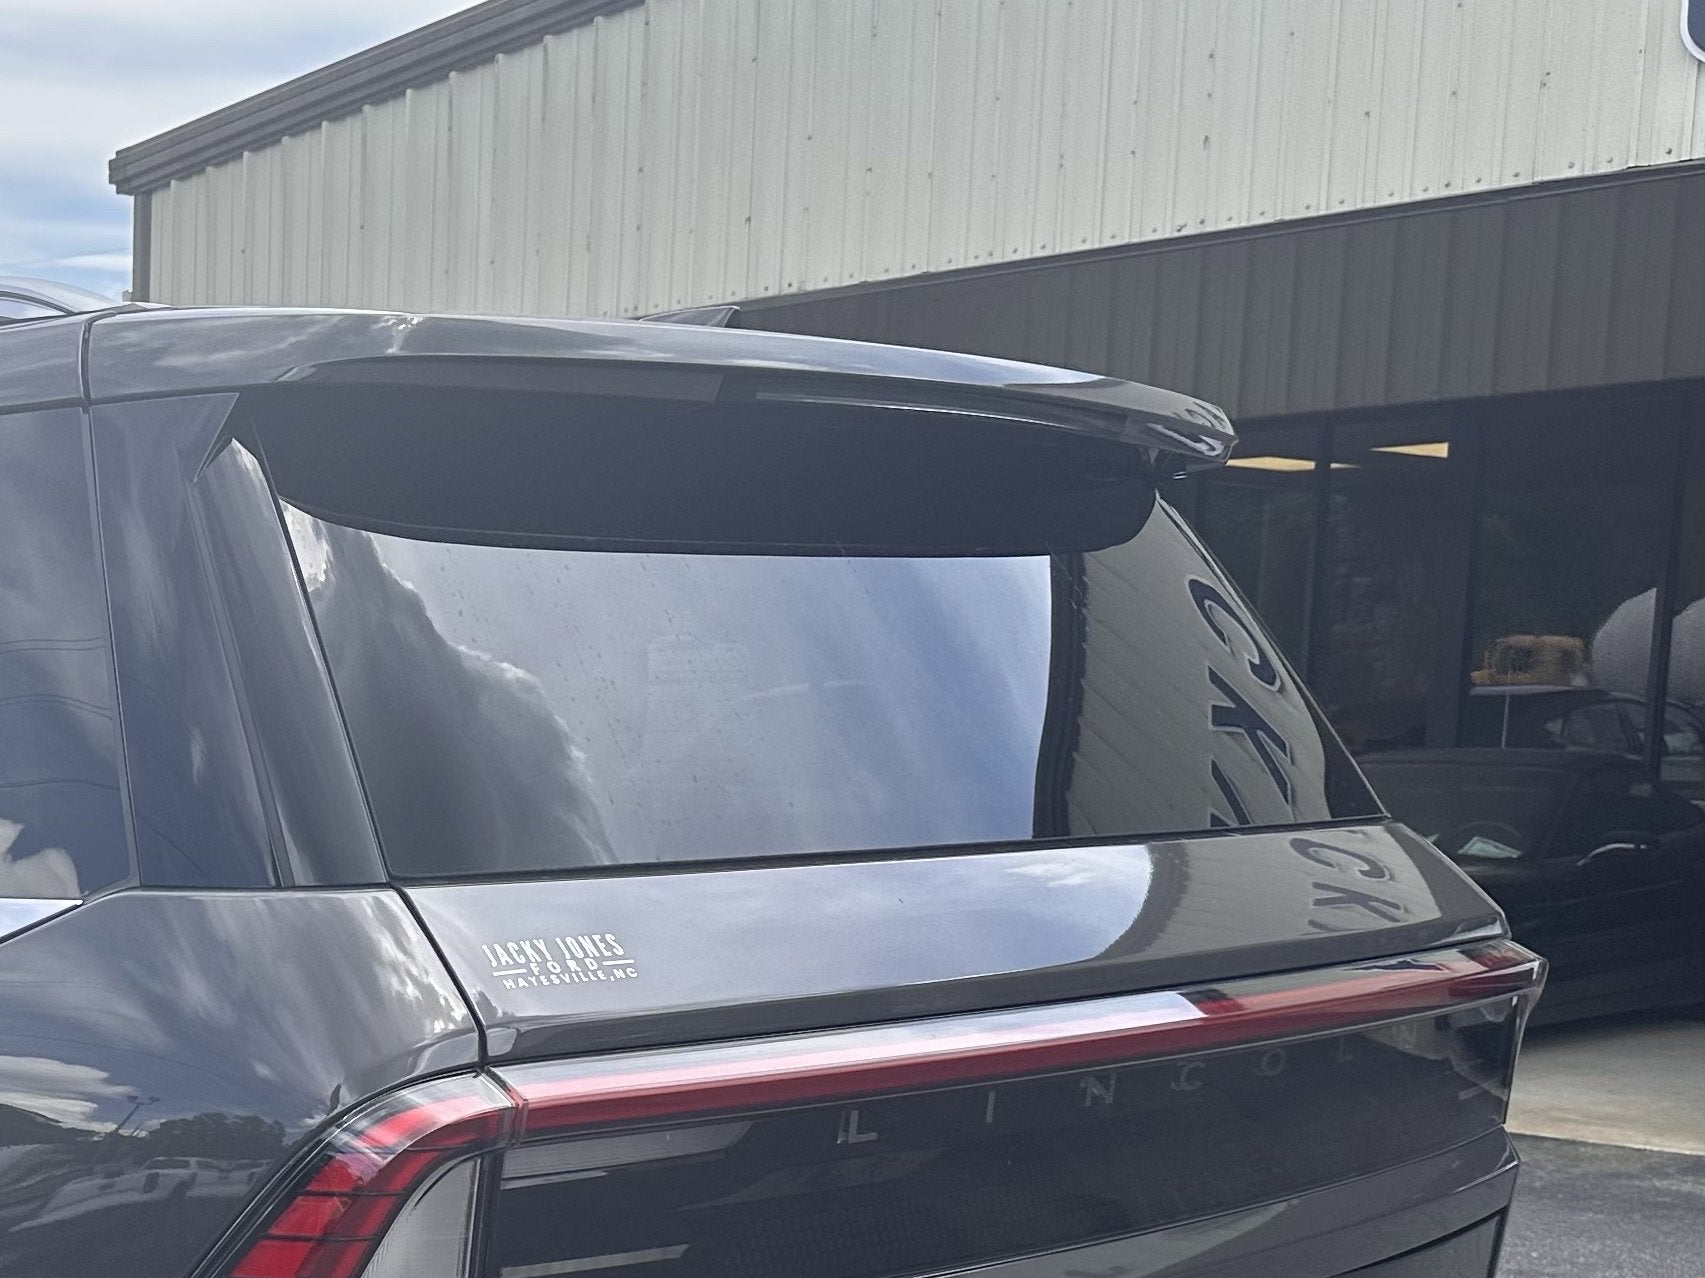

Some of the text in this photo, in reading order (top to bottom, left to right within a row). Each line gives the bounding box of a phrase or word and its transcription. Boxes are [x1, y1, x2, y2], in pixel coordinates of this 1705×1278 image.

[481, 933, 625, 968] JACKY JONES
[529, 957, 599, 976] FORD
